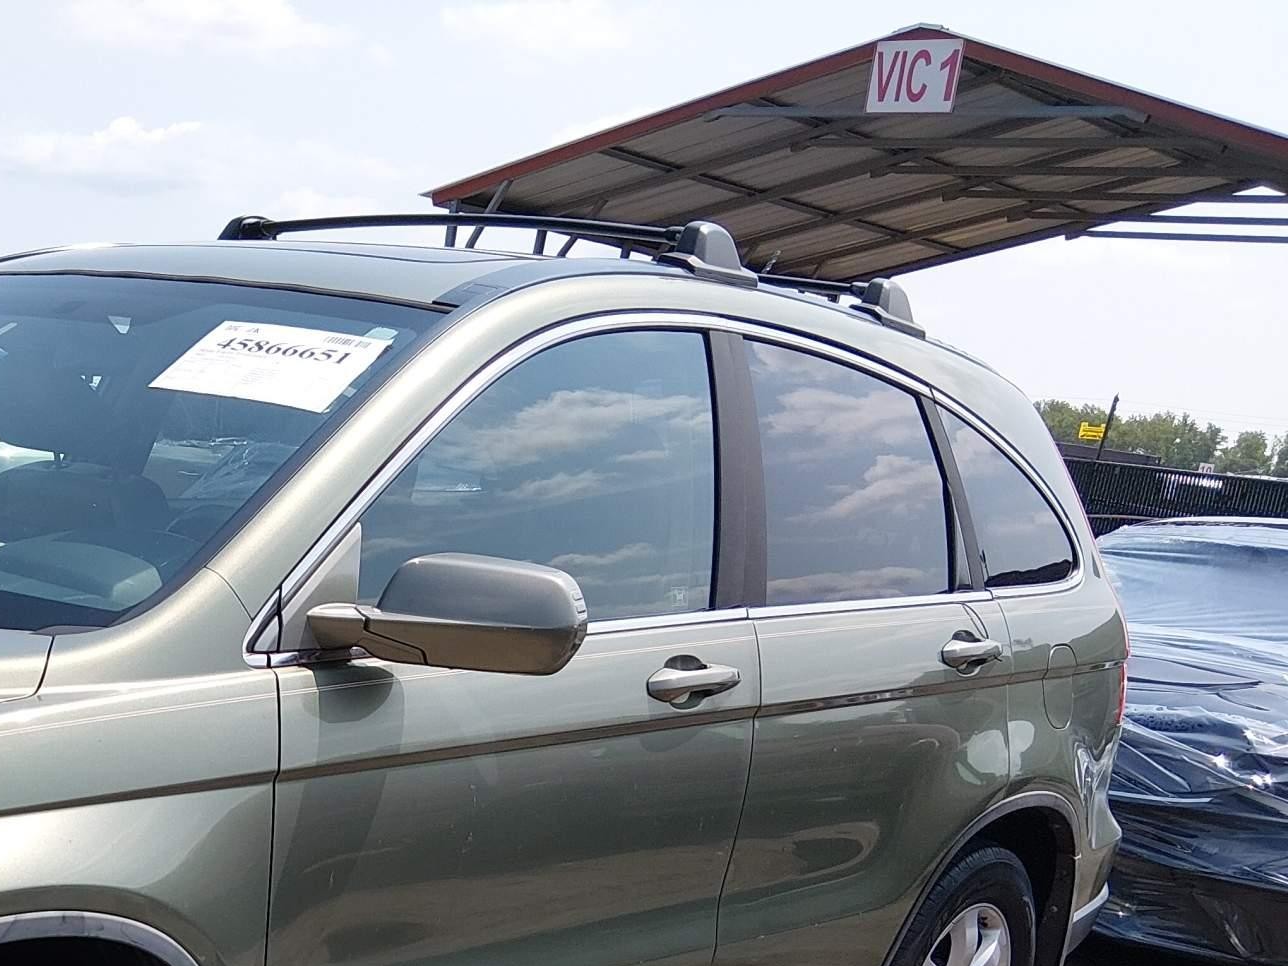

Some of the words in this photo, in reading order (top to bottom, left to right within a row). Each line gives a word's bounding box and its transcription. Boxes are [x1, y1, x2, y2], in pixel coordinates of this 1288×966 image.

[877, 49, 932, 103] VIC
[939, 48, 960, 102] 1
[216, 336, 352, 365] 45866651
